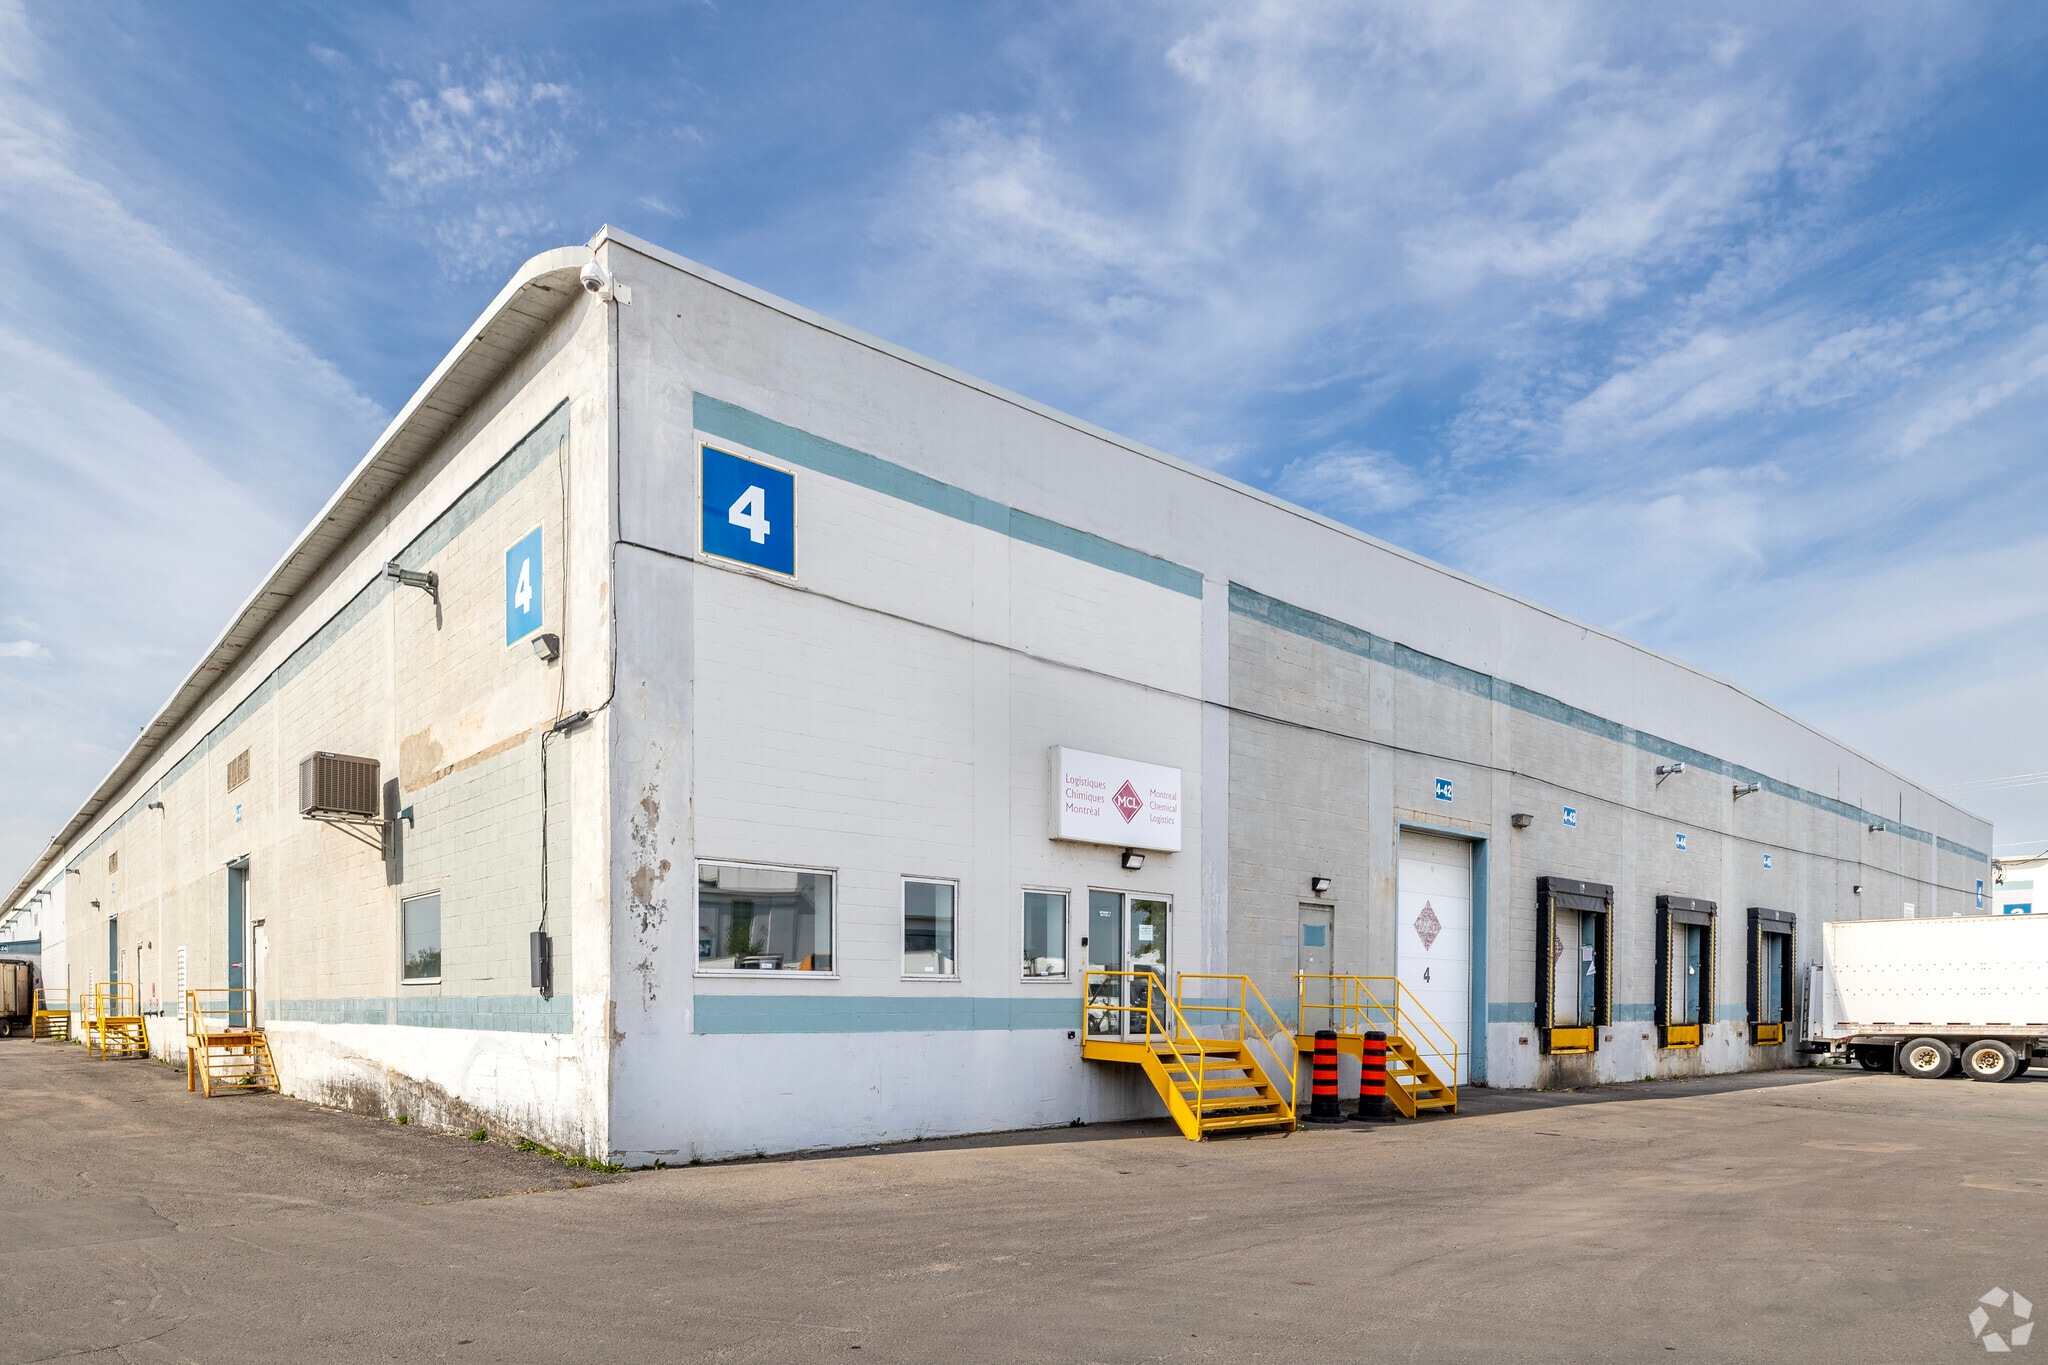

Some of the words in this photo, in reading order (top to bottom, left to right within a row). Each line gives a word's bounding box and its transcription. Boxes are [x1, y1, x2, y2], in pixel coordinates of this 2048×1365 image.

[729, 485, 770, 544] 4
[515, 557, 532, 614] 4
[1065, 773, 1106, 789] Logistiques
[1065, 788, 1104, 803] Chimiques
[1149, 788, 1177, 801] Montreal
[1436, 783, 1452, 797] 4-42
[1065, 802, 1100, 816] Montréal
[1117, 795, 1138, 809] MCL
[1149, 800, 1177, 813] Chemical
[1149, 813, 1175, 825] Logistics
[1423, 967, 1431, 983] 4
